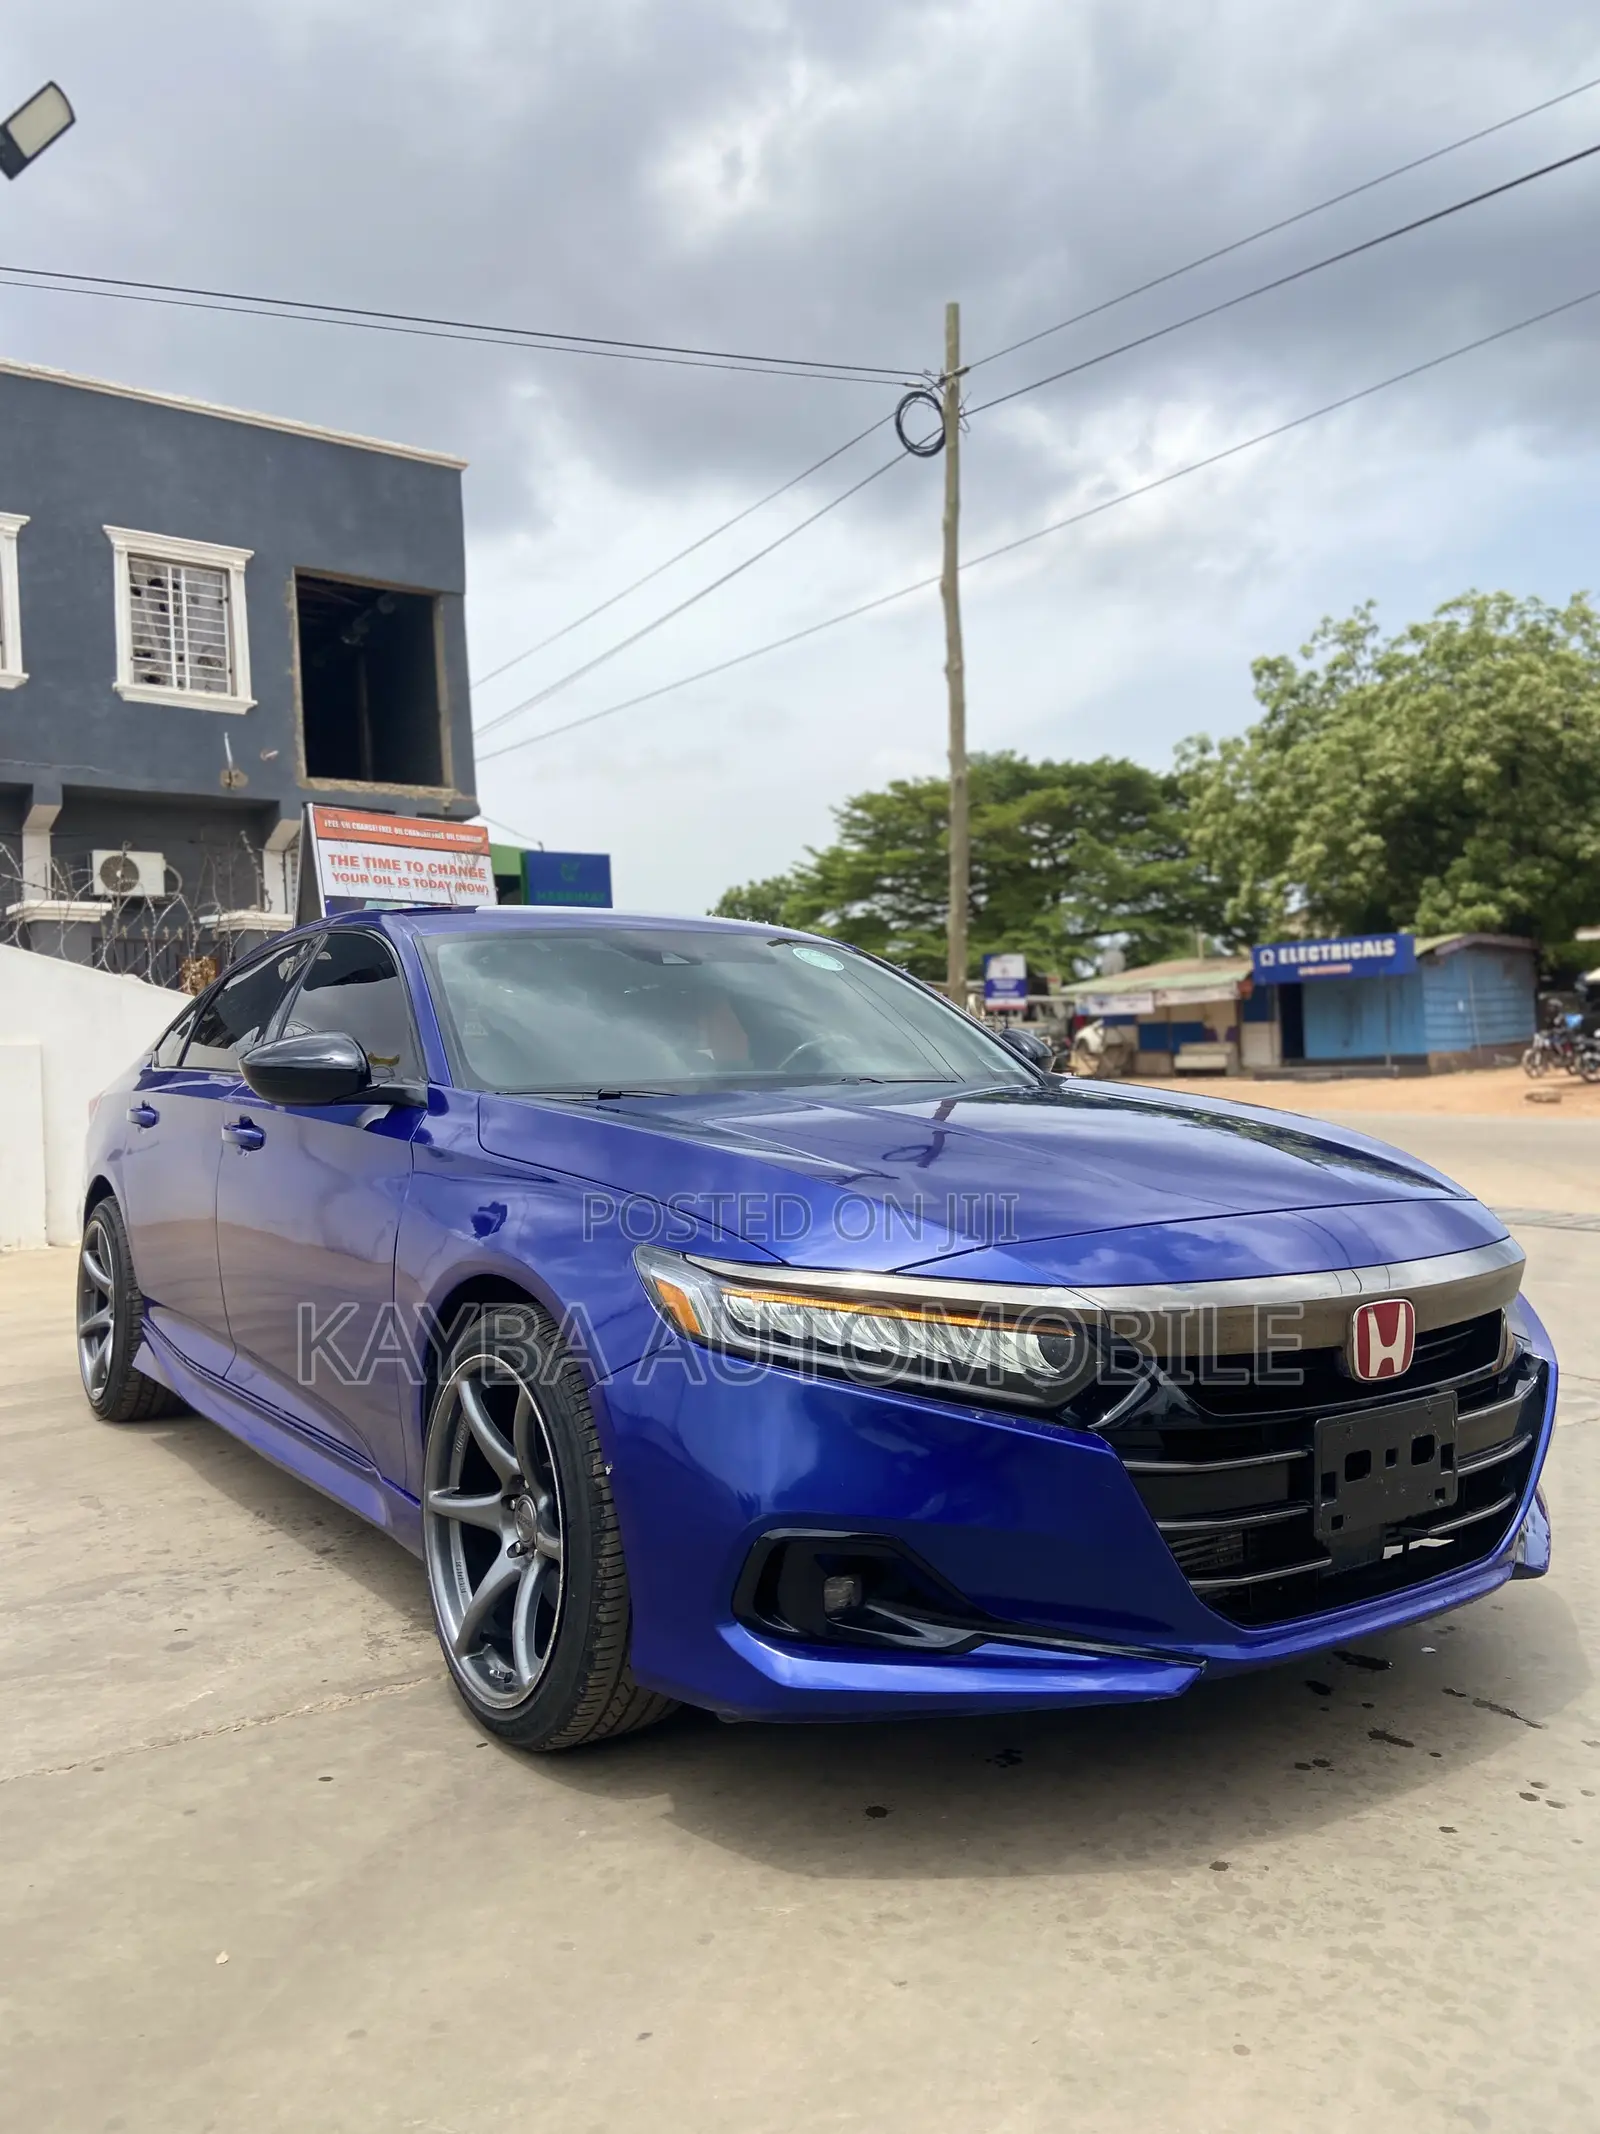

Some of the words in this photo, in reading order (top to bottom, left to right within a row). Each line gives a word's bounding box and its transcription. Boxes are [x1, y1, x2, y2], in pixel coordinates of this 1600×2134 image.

[328, 854, 360, 868] THE
[363, 856, 401, 871] TIME
[405, 860, 424, 873] TO
[428, 862, 487, 880] CHANGE
[332, 872, 369, 884] YOUR
[373, 875, 395, 886] OIL
[397, 877, 410, 887] IS
[413, 879, 450, 890] TODAY
[455, 882, 489, 896] (NOW)
[1278, 938, 1396, 965] ELECTRICALS
